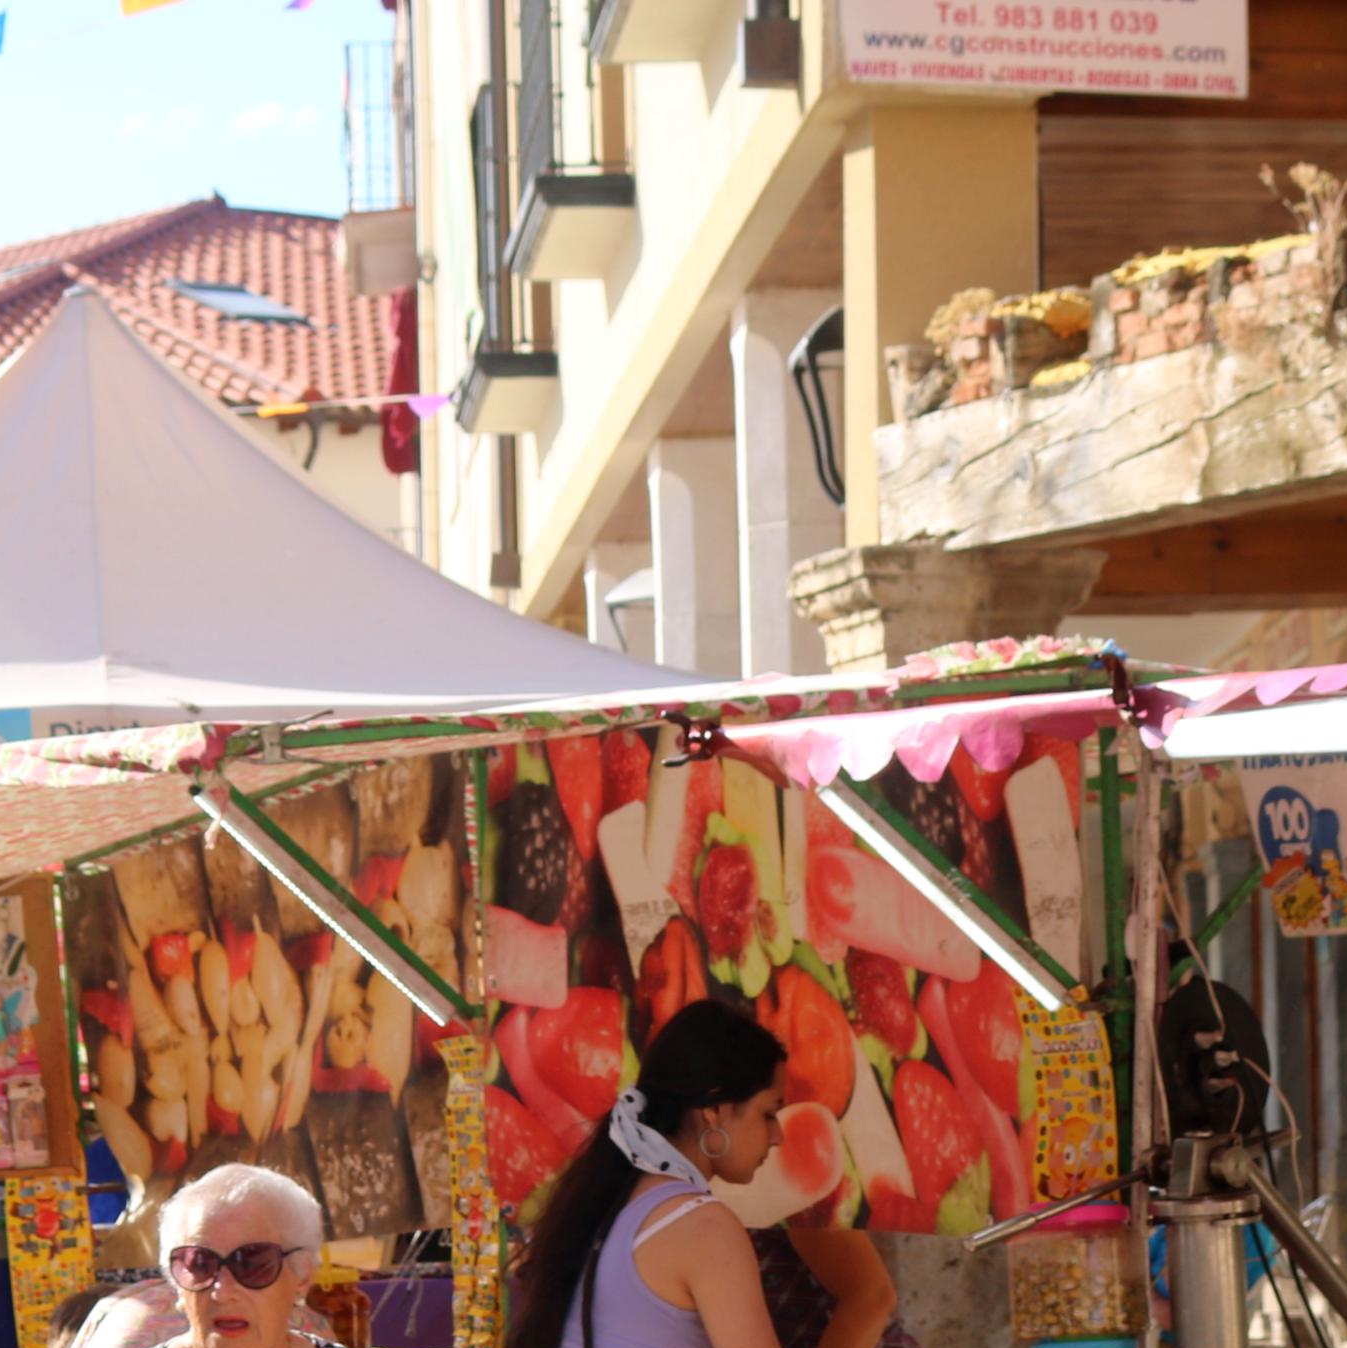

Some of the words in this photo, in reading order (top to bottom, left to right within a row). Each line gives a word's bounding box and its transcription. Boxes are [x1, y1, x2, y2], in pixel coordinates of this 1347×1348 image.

[936, 1, 984, 27] Tel.
[994, 5, 1043, 29] 983
[1053, 8, 1098, 32] 881
[1110, 10, 1159, 35] 039
[864, 31, 1227, 62] www.cgconstrucciones.com
[910, 63, 985, 81] VIVIENDAS
[1086, 69, 1151, 88] BODEGAS
[1162, 72, 1199, 91] OBRA
[1261, 798, 1310, 842] 100
